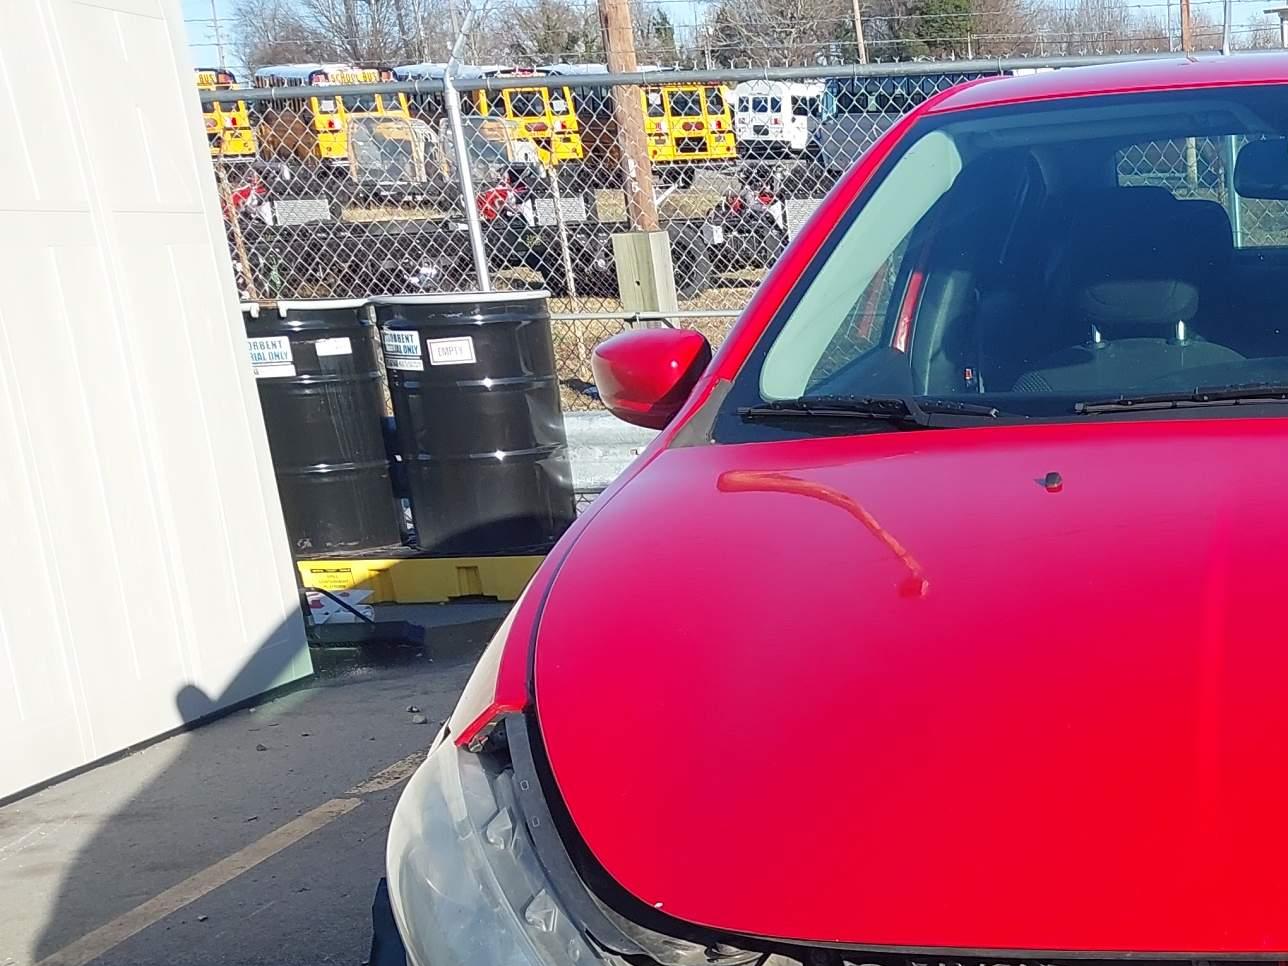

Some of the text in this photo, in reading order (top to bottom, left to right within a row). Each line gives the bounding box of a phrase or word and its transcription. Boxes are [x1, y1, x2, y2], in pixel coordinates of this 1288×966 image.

[330, 71, 377, 83] SCHOOL BUS
[402, 344, 418, 355] ONLY
[268, 351, 288, 361] ONLY
